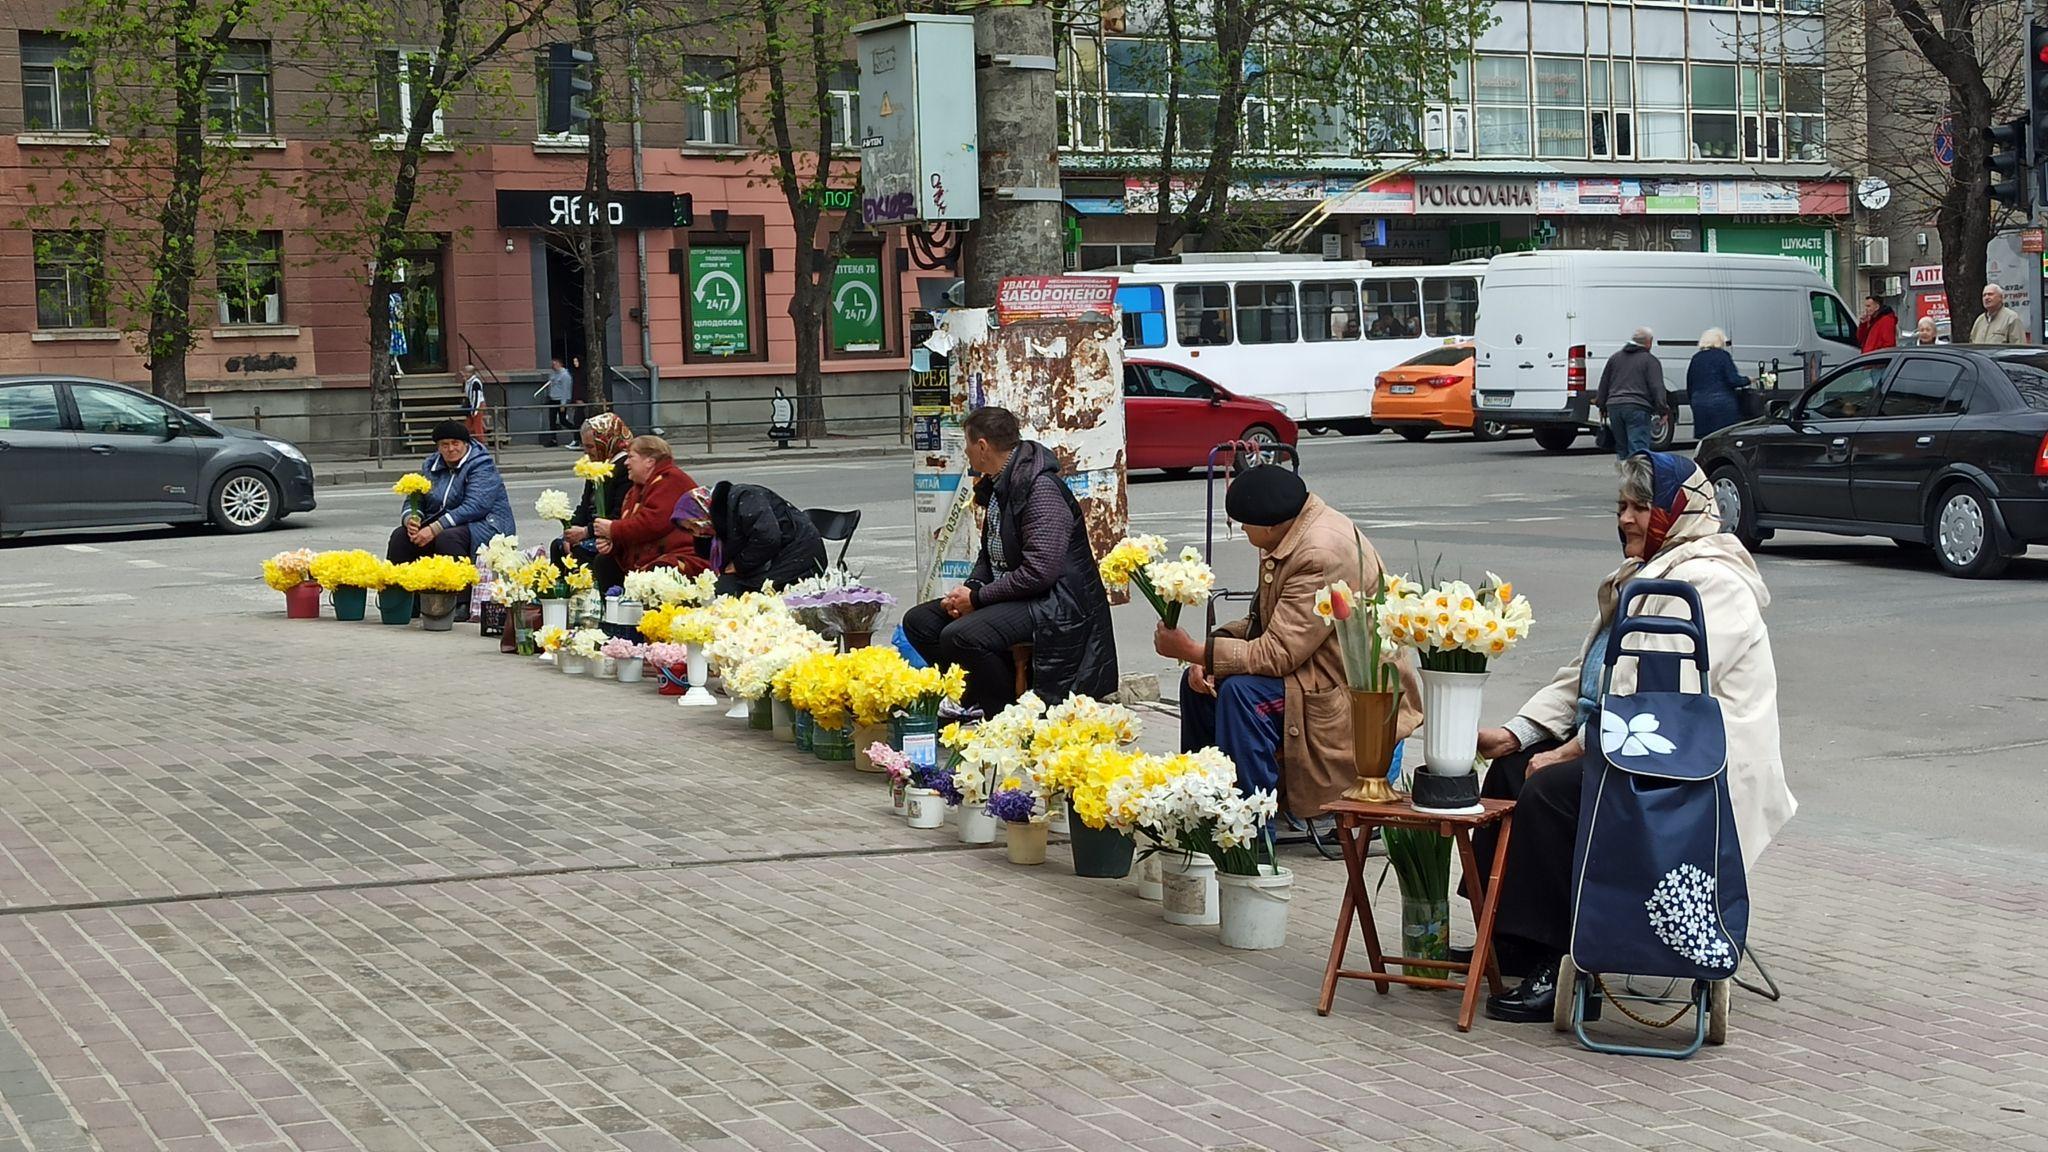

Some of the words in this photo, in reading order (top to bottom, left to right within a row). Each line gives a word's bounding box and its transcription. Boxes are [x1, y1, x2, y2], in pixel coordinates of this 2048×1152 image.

[1419, 184, 1533, 207] РОКСОЛАНА
[1781, 238, 1822, 249] ШУКАЄТЕ
[1915, 269, 1941, 282] АПТ
[1003, 280, 1040, 290] УВАГА!
[1000, 288, 1112, 302] ЗАБОРОНЕНО!
[706, 299, 730, 311] 24/7
[845, 309, 867, 322] 24/7
[693, 320, 743, 328] ЦІЛОДОБОВА
[945, 486, 969, 533] 0352.ua
